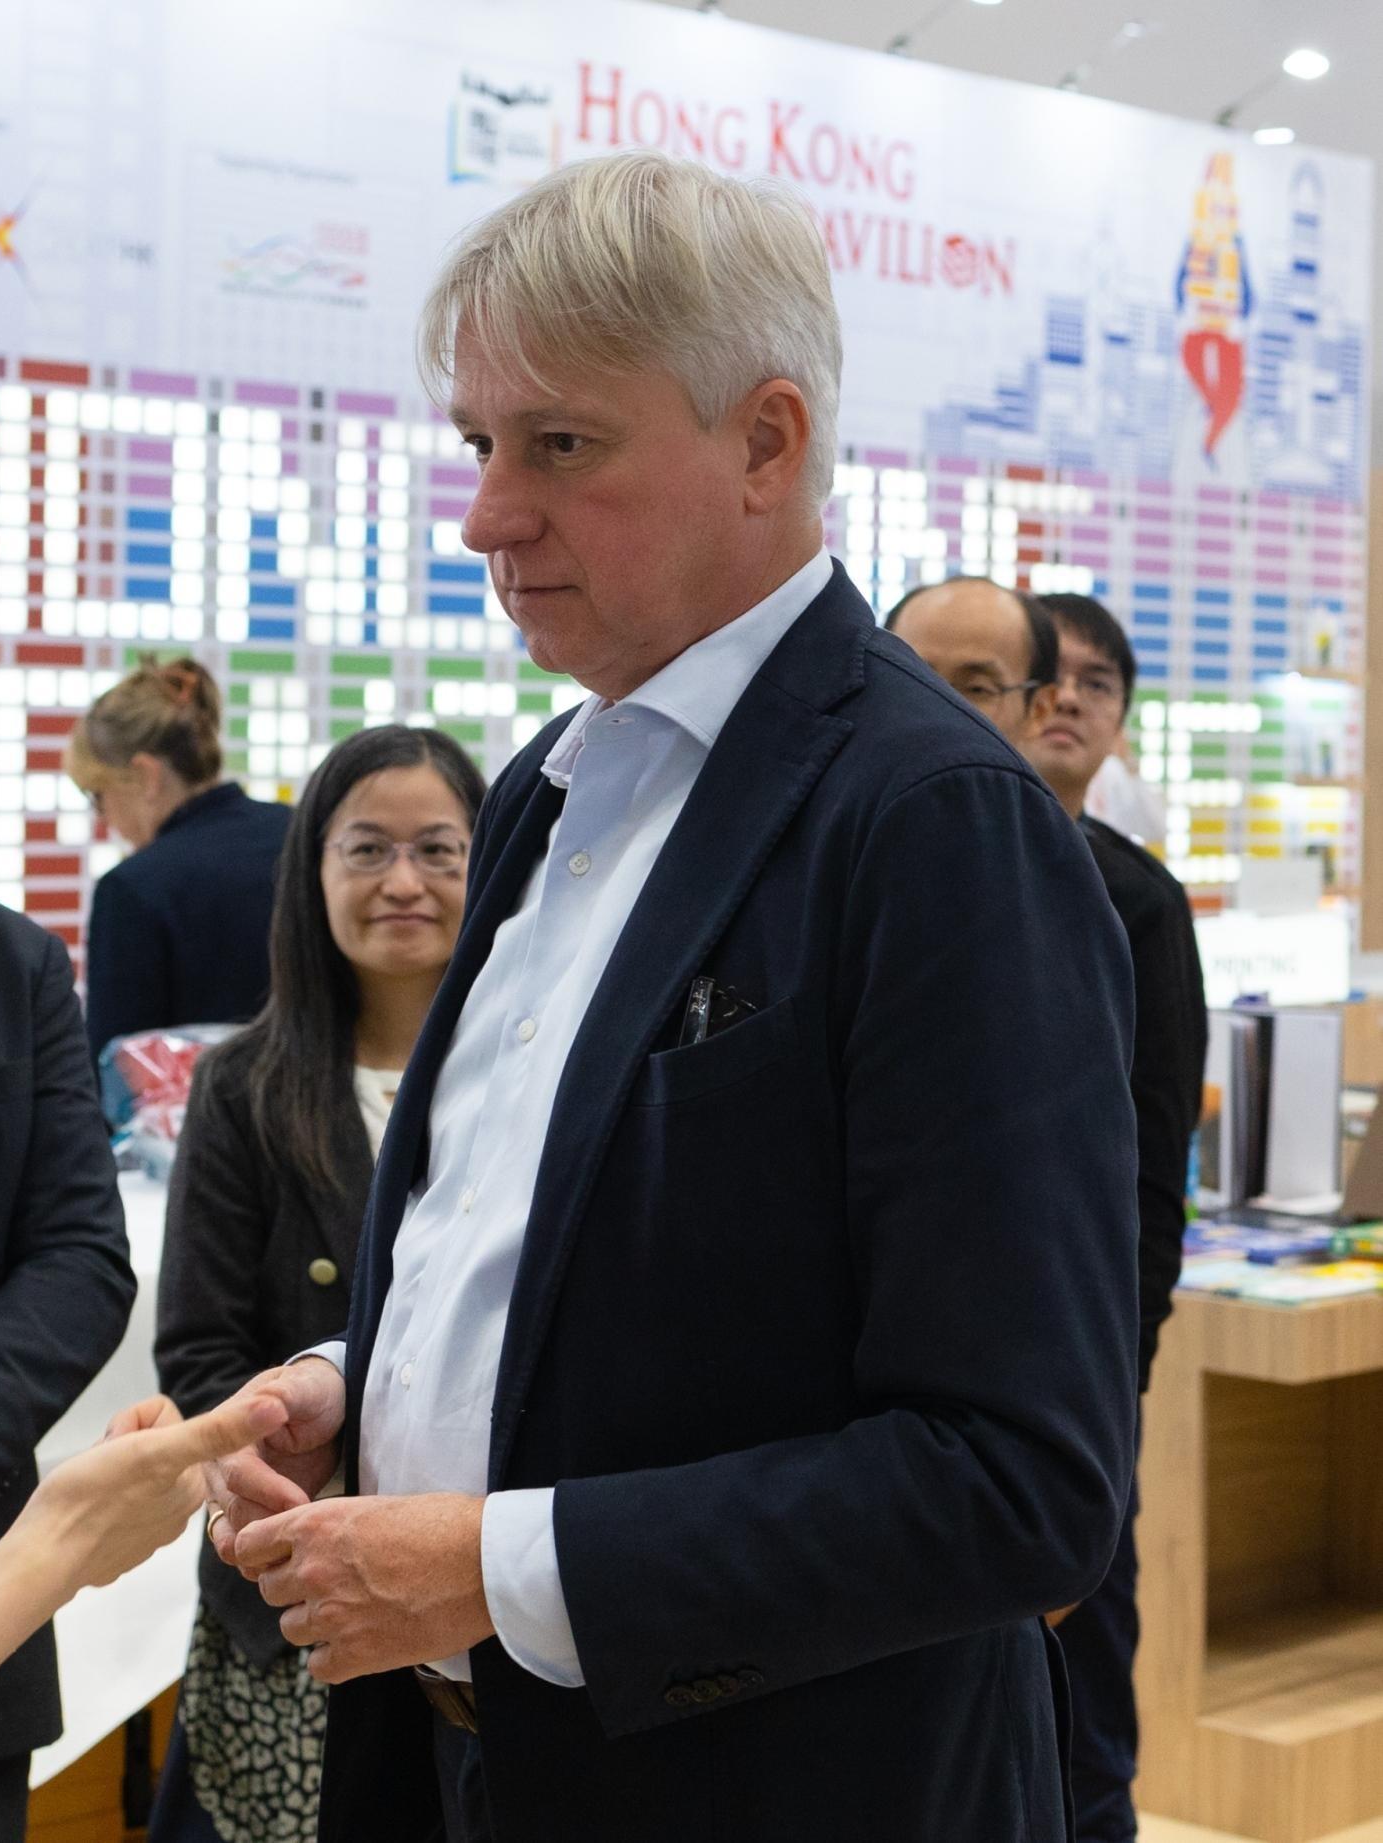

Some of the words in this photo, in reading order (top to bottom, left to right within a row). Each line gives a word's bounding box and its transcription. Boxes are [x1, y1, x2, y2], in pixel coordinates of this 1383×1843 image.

[577, 61, 747, 171] HONG
[768, 99, 917, 204] KONG
[814, 207, 1018, 298] AVILION
